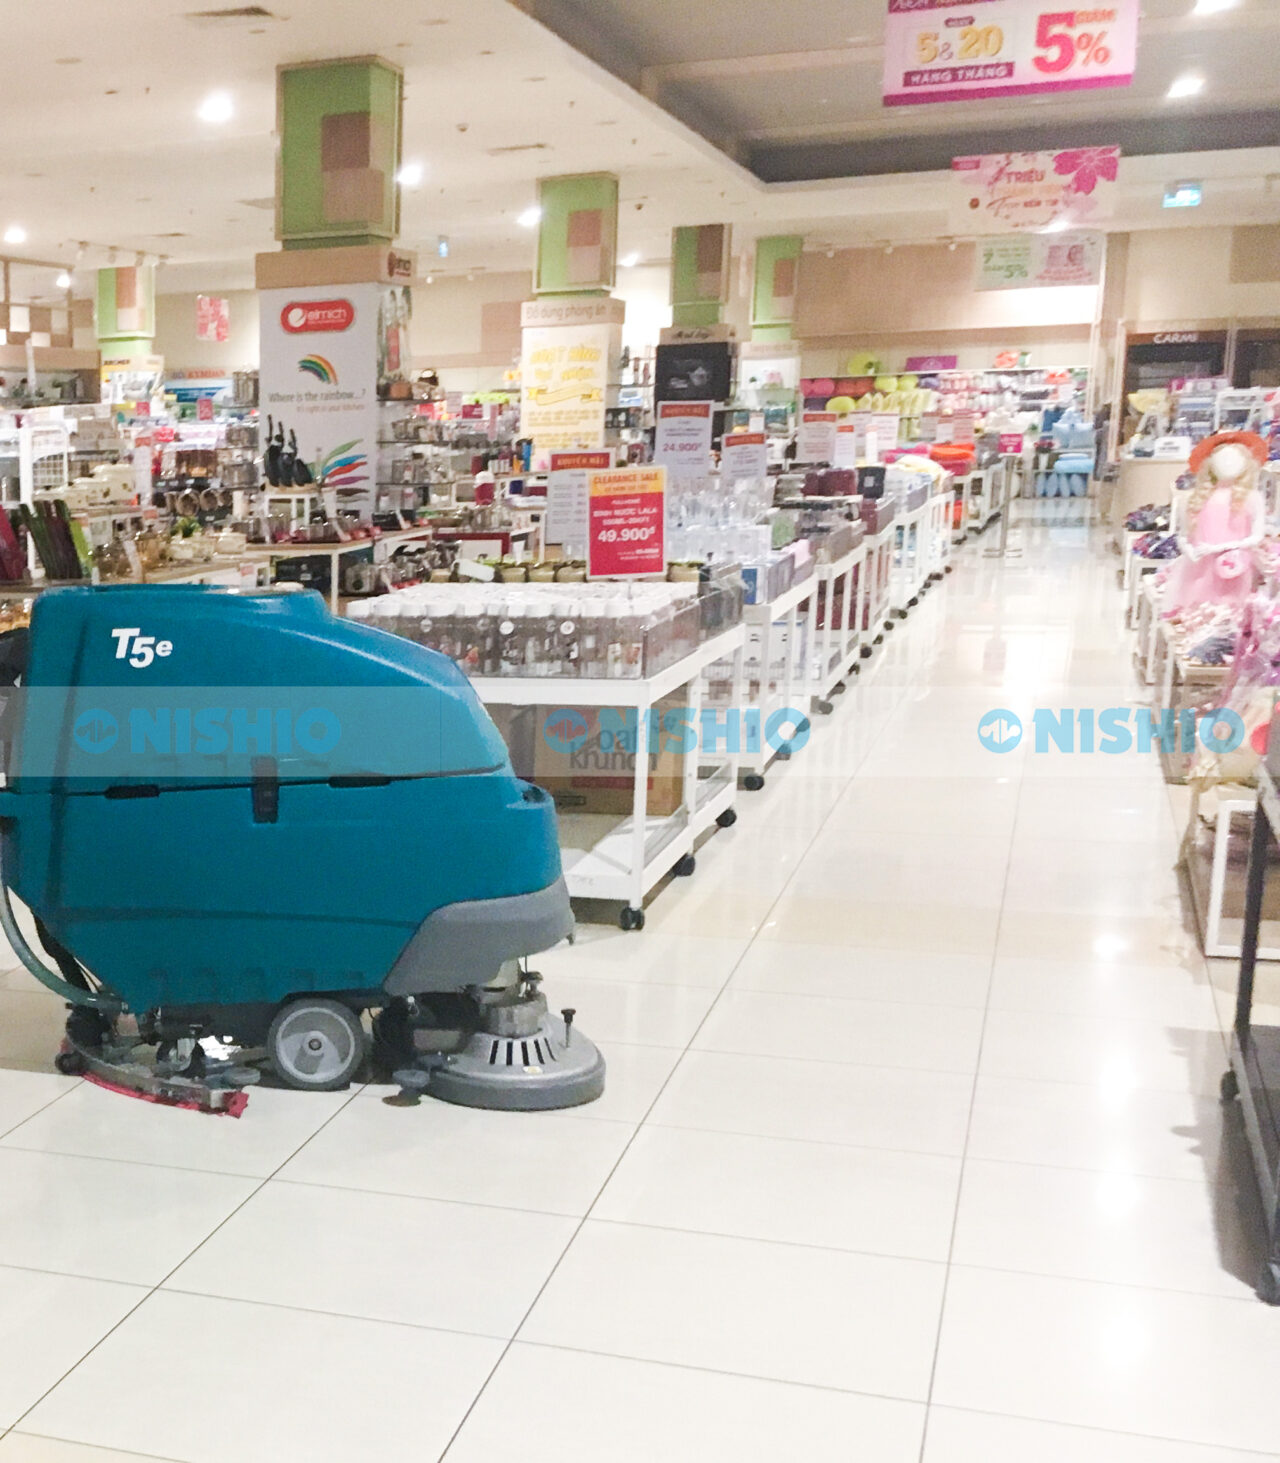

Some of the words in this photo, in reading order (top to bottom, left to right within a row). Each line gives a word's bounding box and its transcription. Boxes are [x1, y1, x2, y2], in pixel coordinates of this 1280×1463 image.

[917, 32, 939, 64] 5
[957, 25, 1004, 60] 20
[268, 391, 294, 403] Where
[296, 391, 303, 401] is
[305, 390, 318, 401] the
[593, 473, 637, 484] CLEARANCE
[640, 472, 658, 482] SALE
[111, 628, 173, 668] T5e
